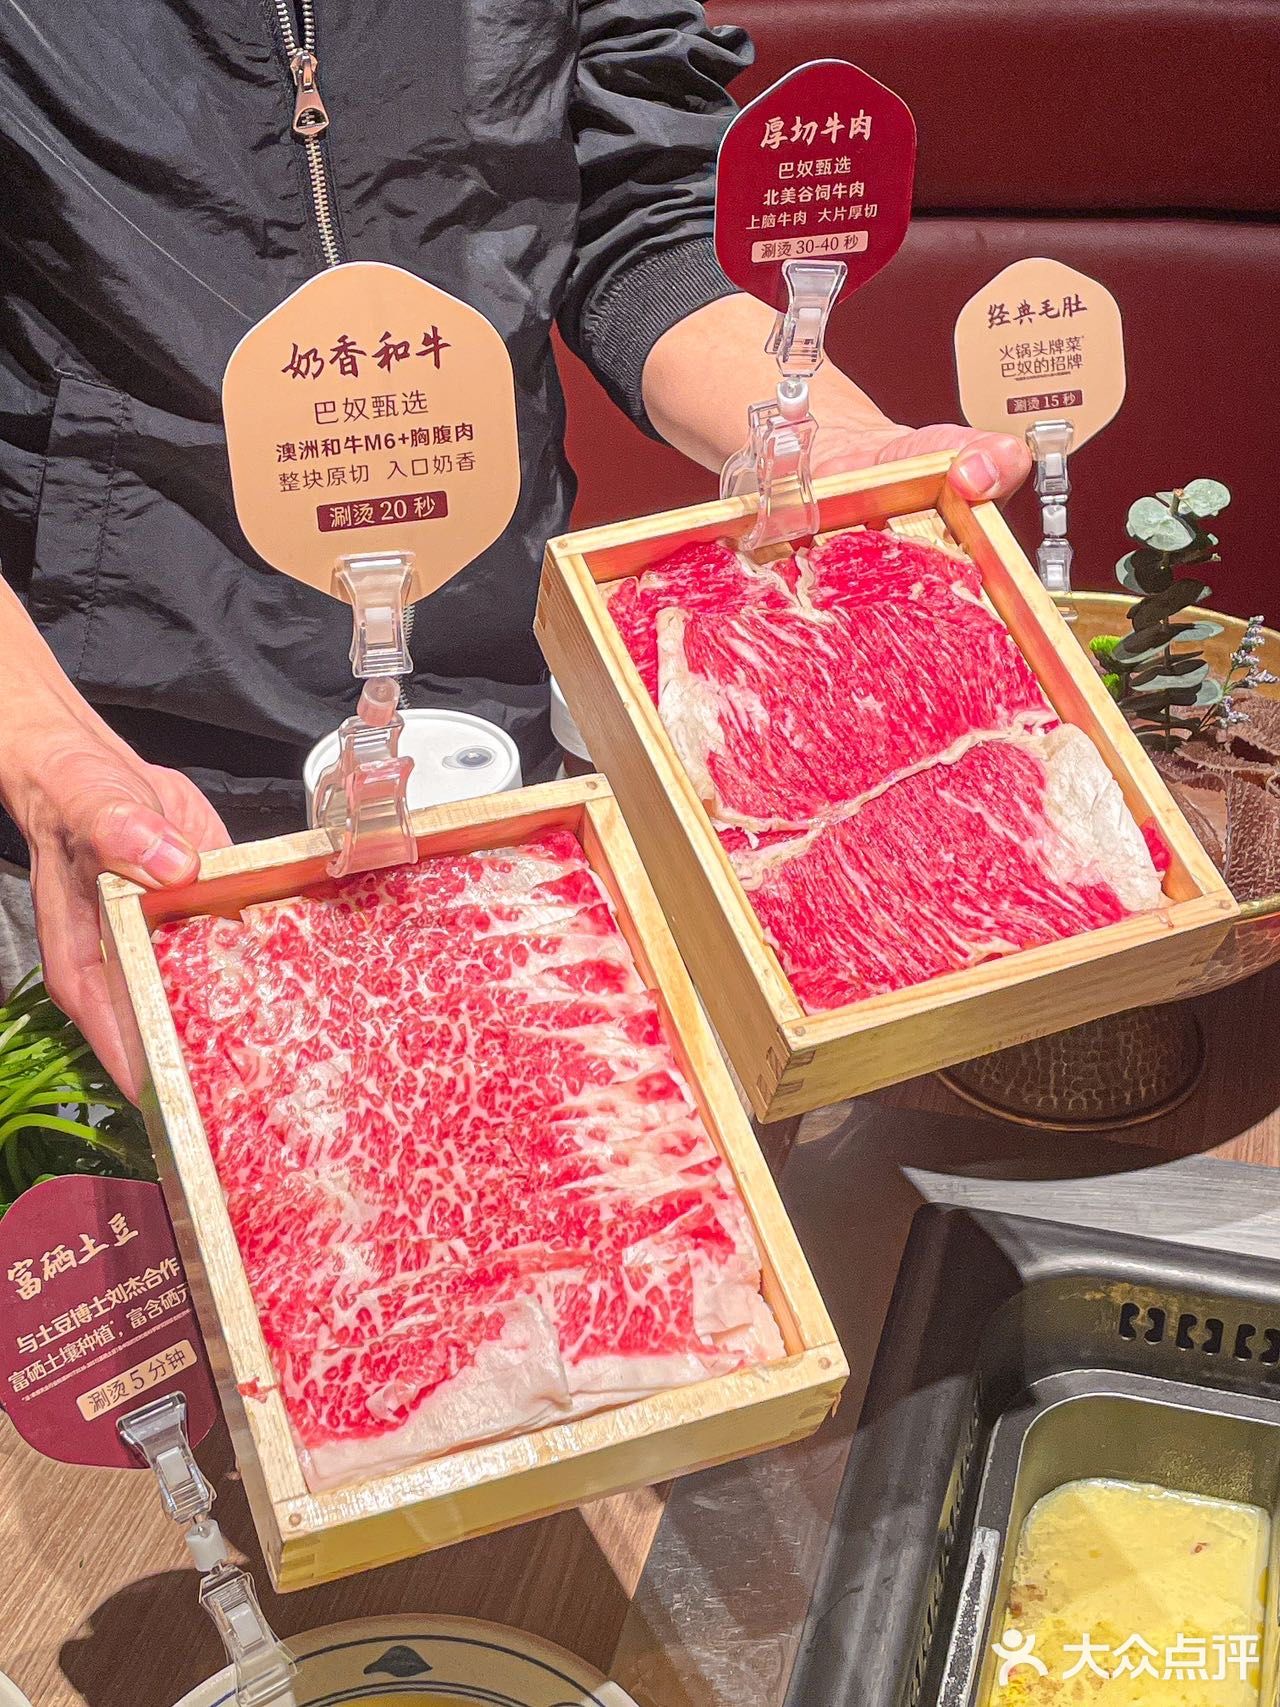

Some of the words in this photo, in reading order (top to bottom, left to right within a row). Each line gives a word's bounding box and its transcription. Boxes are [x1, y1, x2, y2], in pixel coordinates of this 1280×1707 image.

[760, 109, 873, 150] 厚切牛肉
[778, 155, 851, 180] 巴奴甄选
[763, 181, 865, 206] 北美谷饲牛肉
[745, 211, 807, 230] 上脑牛肉
[817, 203, 878, 223] 大片厚切
[988, 293, 1088, 329] 经典毛肚
[281, 325, 452, 380] 奶香和牛
[1001, 353, 1083, 378] 巴奴的招牌
[314, 390, 429, 425] 巴奴甄选
[275, 422, 474, 463] 澳洲和牛M6+胸腹肉
[278, 464, 370, 493] 整块原切
[386, 451, 476, 480] 入口奶香
[7, 1212, 139, 1300] 富硒土豆
[16, 1257, 180, 1354] 与土豆博士刘杰合作
